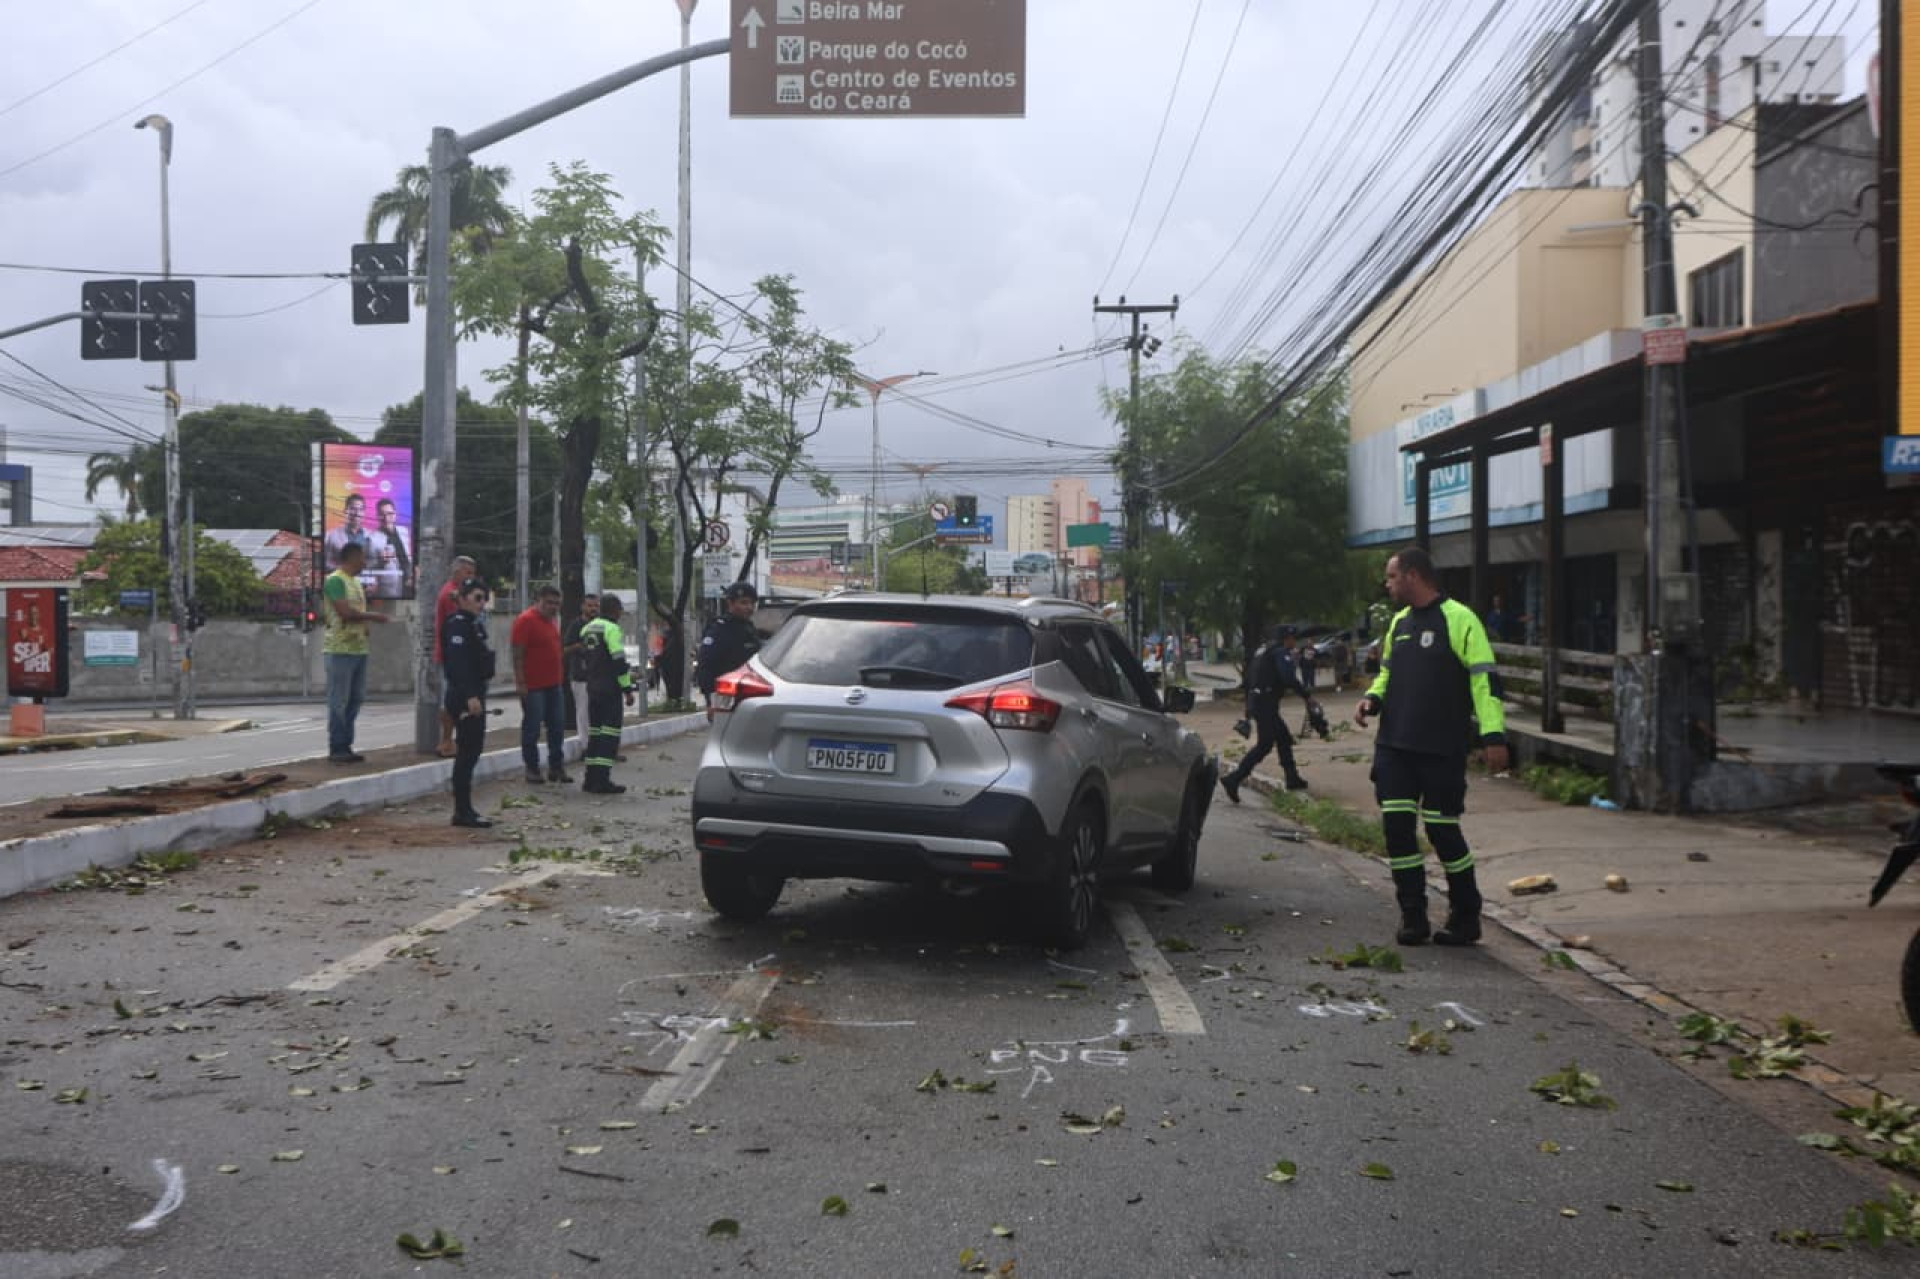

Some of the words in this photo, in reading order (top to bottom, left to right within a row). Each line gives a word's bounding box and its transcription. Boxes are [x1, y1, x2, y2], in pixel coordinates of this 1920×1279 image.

[809, 1, 860, 20] Beira
[867, 3, 904, 20] Mar
[809, 41, 877, 63] Parque
[884, 42, 909, 59] do
[917, 39, 967, 59] Cocó
[809, 70, 885, 88] Centro
[893, 70, 920, 87] de
[929, 70, 1017, 87] Eventos
[809, 93, 837, 110] do
[845, 92, 912, 110] Ceará
